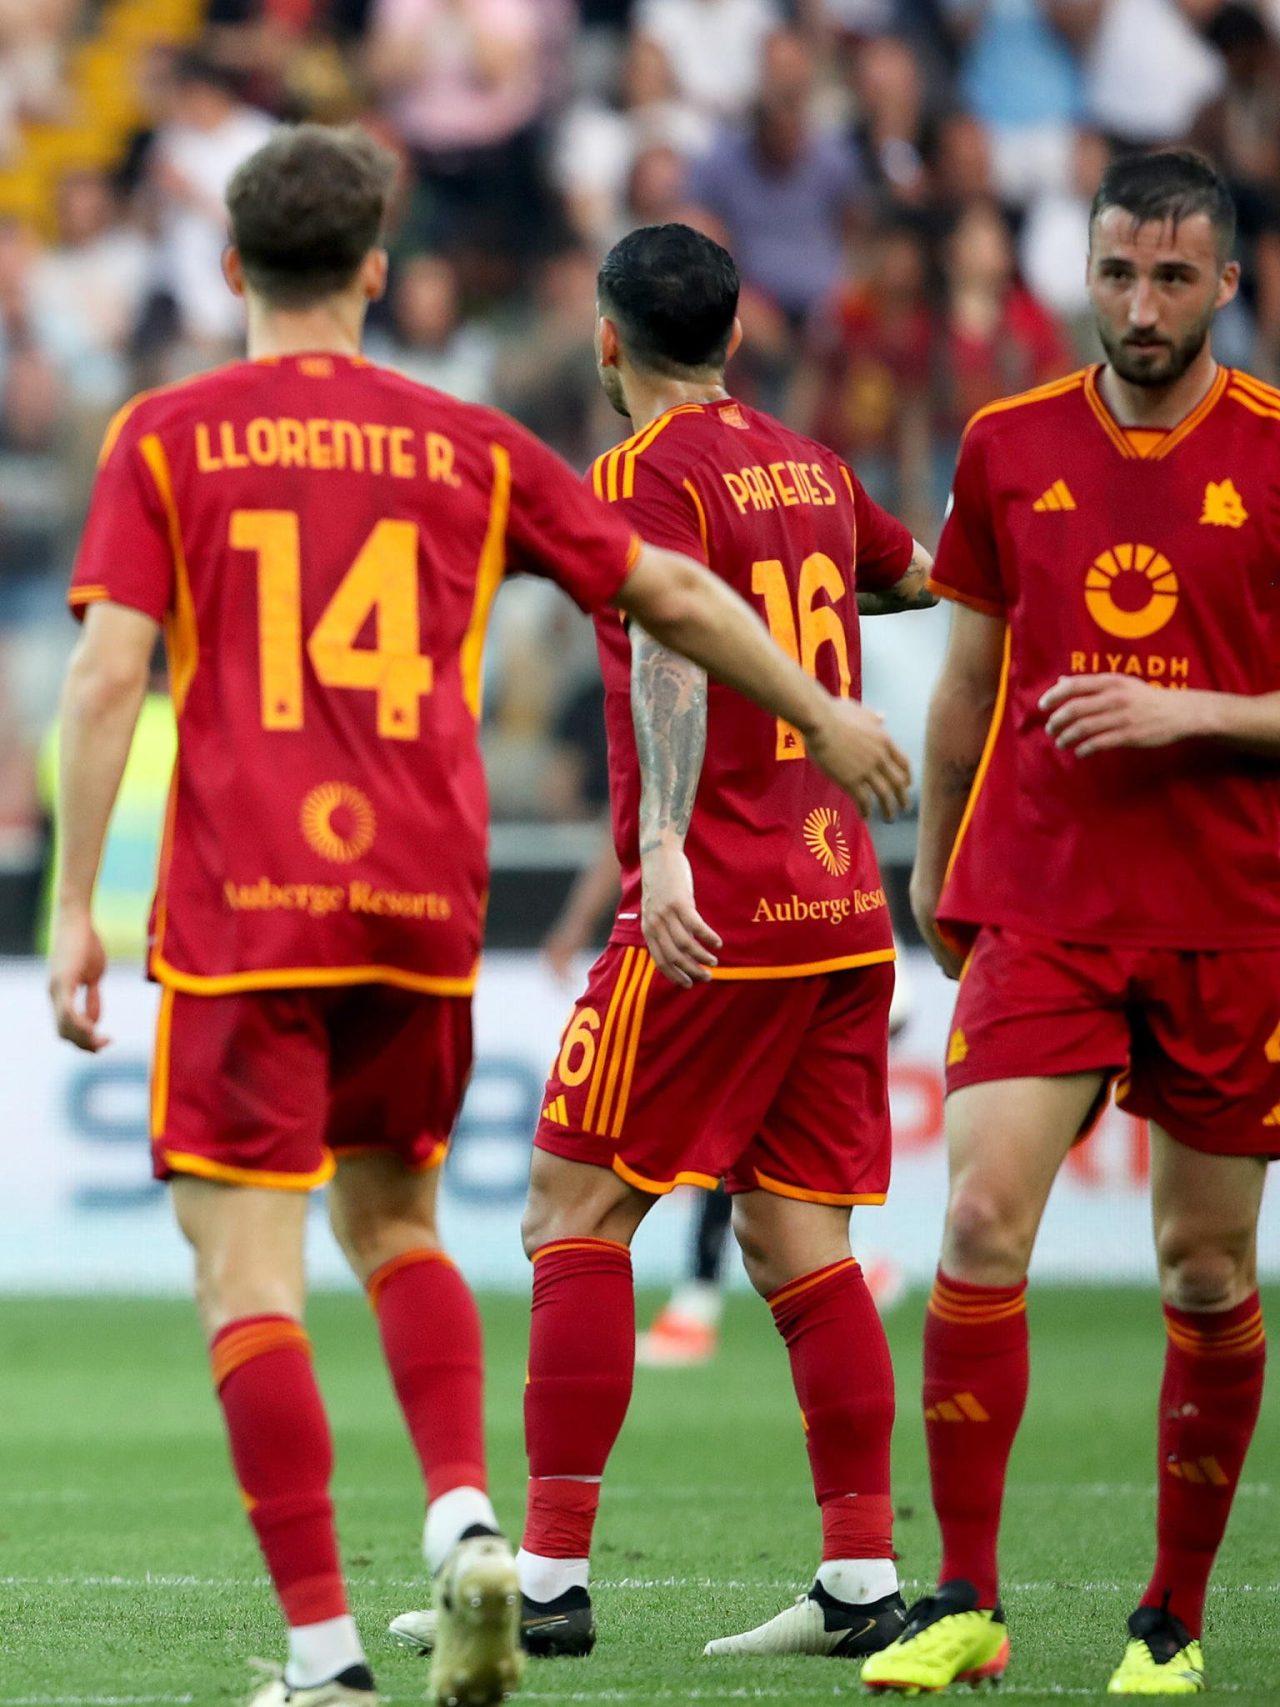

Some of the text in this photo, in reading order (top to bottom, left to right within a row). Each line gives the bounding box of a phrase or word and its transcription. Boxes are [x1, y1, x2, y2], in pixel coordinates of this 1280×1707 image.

[195, 417, 462, 488] LLORENTE R.
[722, 460, 837, 514] PAREDES
[230, 509, 434, 742] 14
[751, 552, 852, 761] 16
[1071, 651, 1190, 678] RIYADH
[751, 894, 851, 925] Auberge
[549, 1004, 601, 1087] 6
